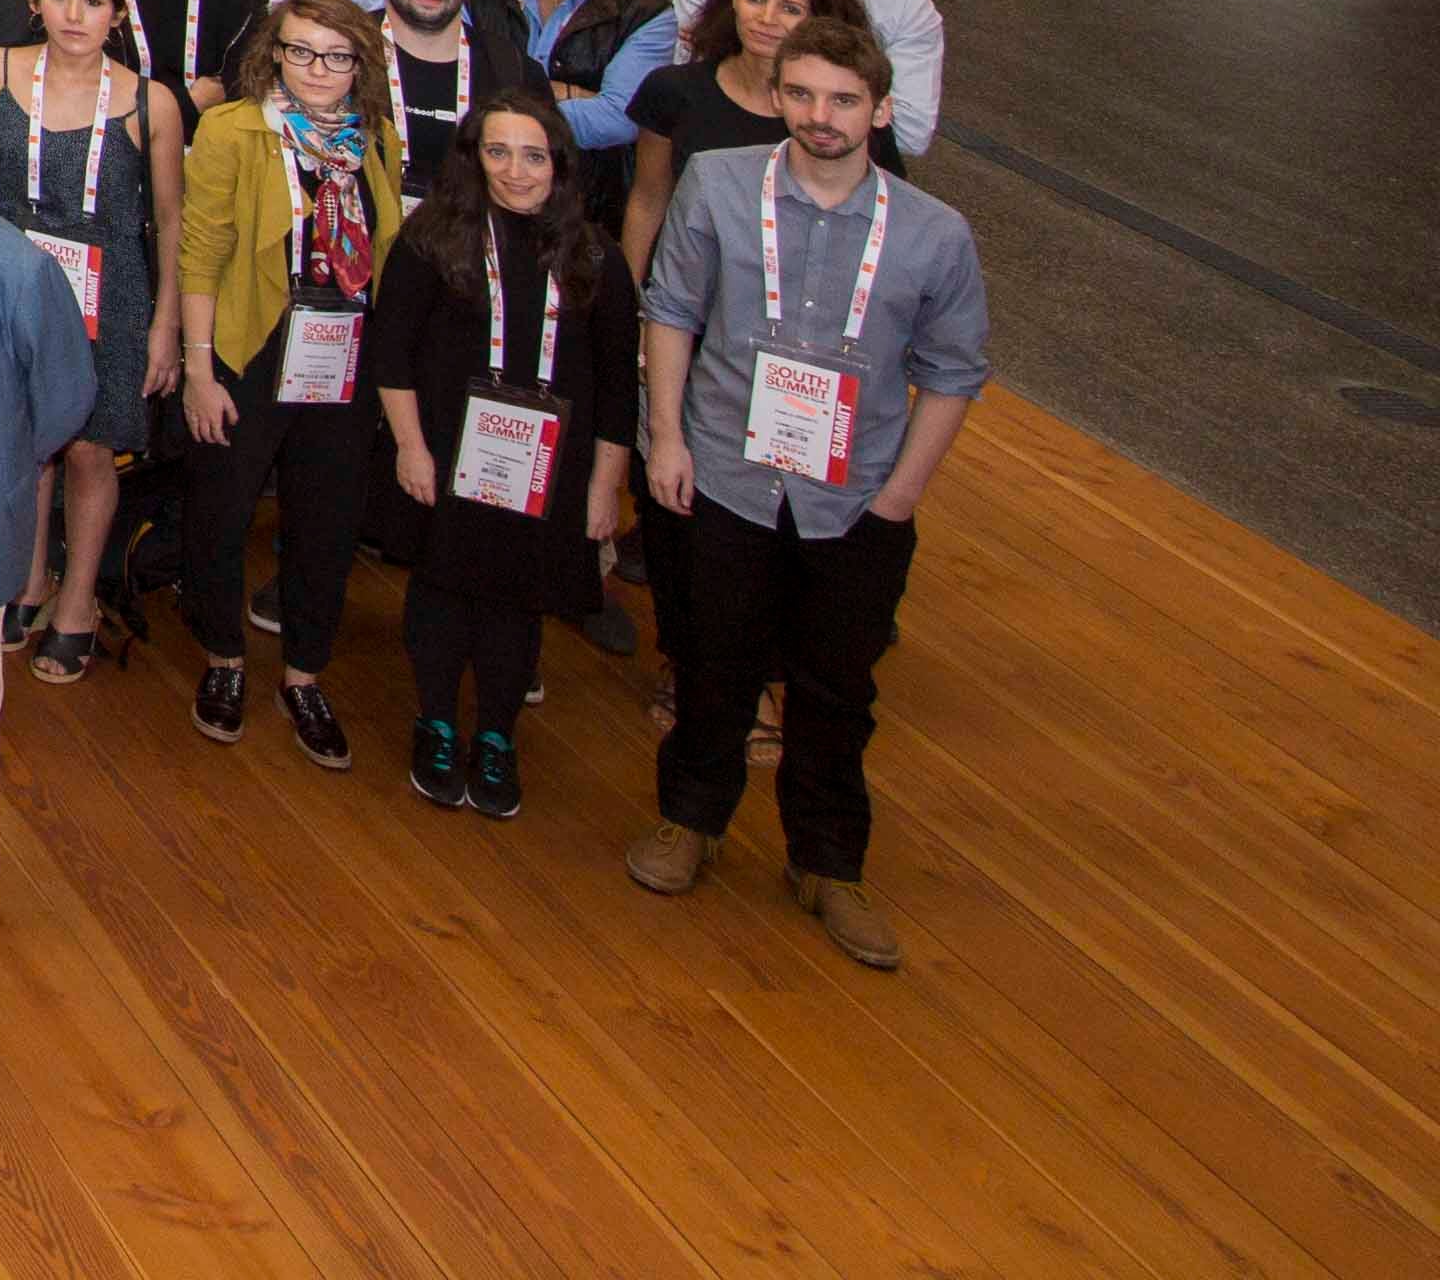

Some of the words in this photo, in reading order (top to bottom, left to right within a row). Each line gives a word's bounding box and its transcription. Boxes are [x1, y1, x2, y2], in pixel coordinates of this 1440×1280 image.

[85, 268, 99, 317] SUMMIT
[765, 374, 828, 400] SUMMIT
[767, 362, 831, 390] SOUTH
[476, 422, 533, 443] SUMMIT
[478, 411, 535, 434] SOUTH
[830, 400, 852, 459] SUMMIT
[531, 442, 553, 494] SUMMIT
